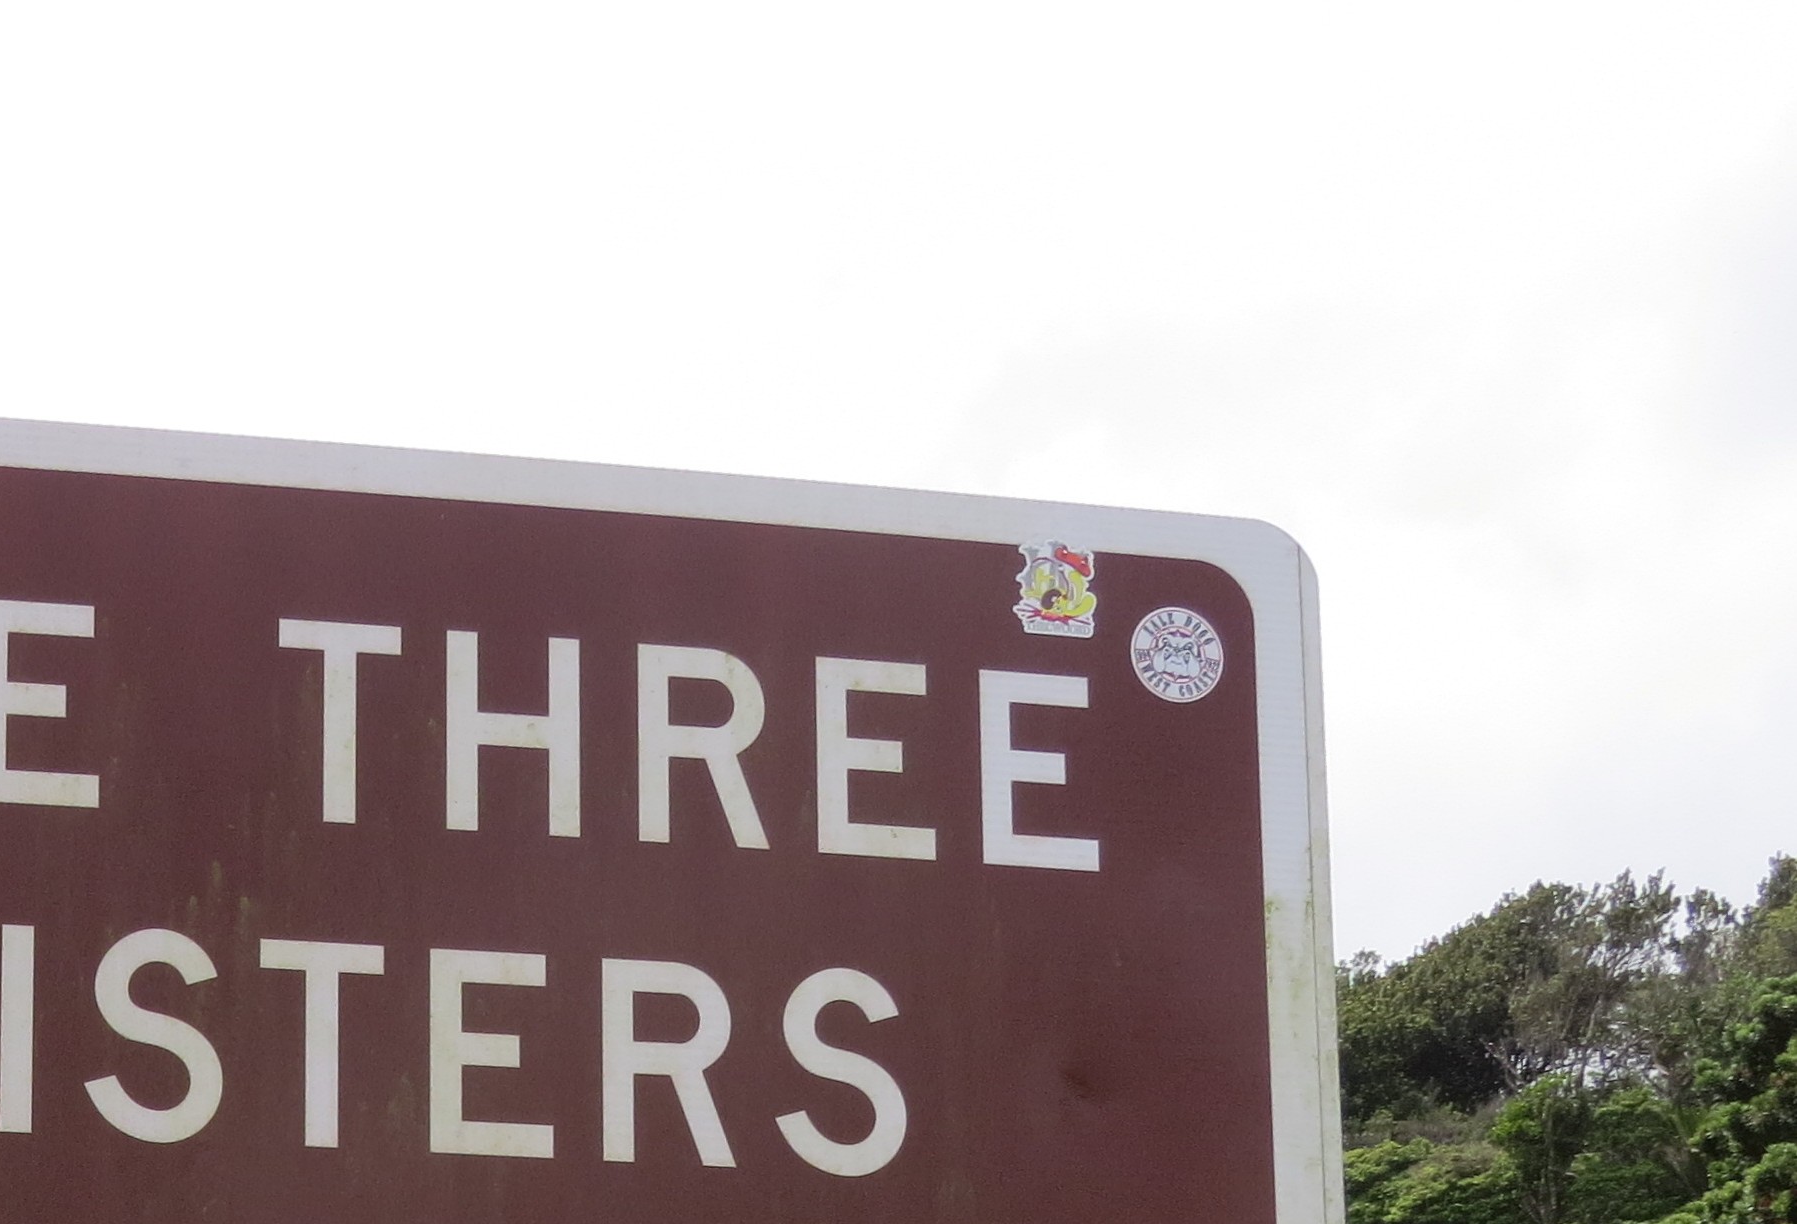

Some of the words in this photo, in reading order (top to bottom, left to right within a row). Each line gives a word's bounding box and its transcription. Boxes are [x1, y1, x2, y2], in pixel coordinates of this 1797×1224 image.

[278, 619, 1101, 873] THREE
[1141, 663, 1171, 693] WEST
[1178, 670, 1215, 697] COAST
